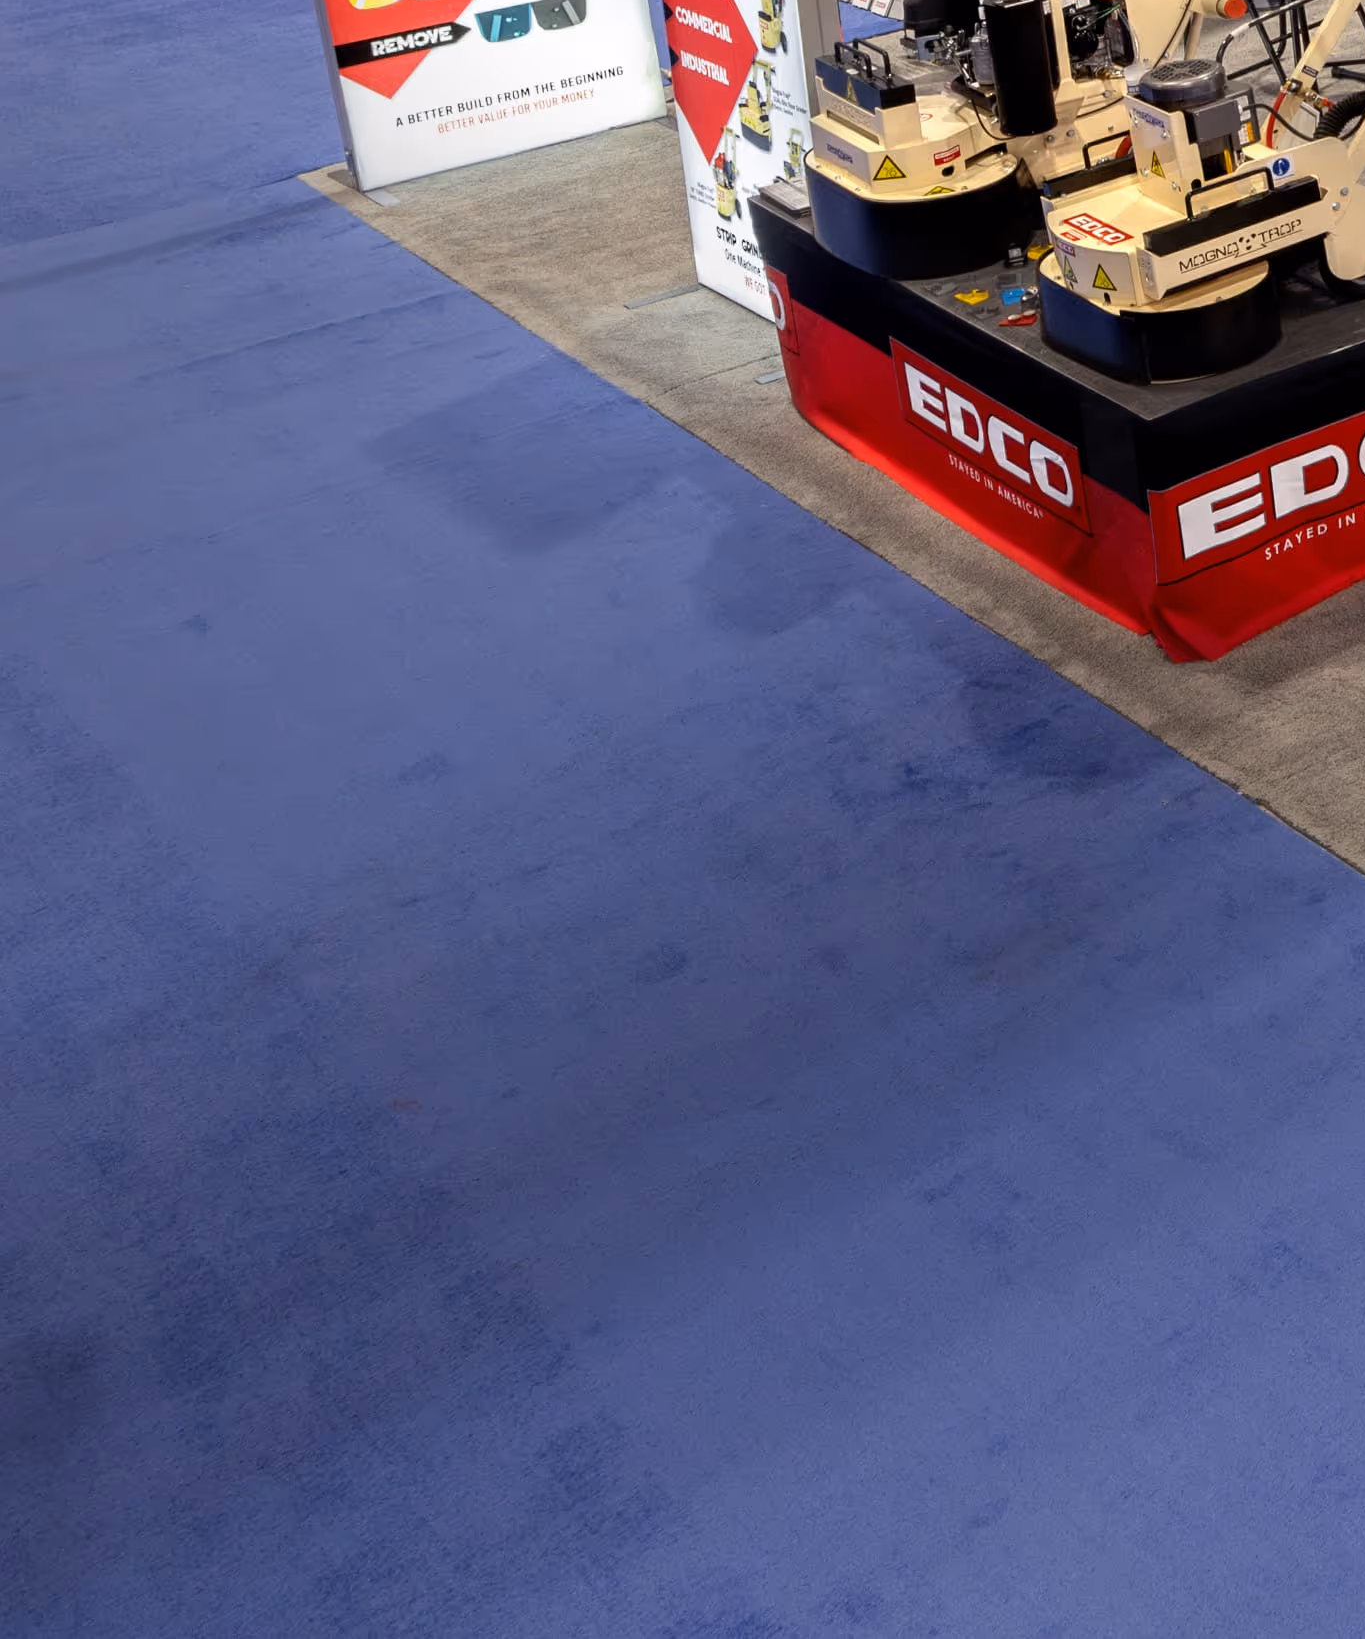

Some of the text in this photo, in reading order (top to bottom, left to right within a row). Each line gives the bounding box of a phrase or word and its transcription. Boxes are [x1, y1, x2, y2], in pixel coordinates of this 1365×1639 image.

[370, 26, 453, 56] REMOVE
[675, 7, 733, 44] COMMERCIAL
[680, 50, 730, 86] INDUSTRIAL
[396, 66, 624, 127] A BETTER BUILD FROM THE BEGINNING
[438, 90, 595, 134] BETTER VALUE FOR YOUR MONEY
[1066, 213, 1128, 245] EDCO
[904, 361, 1075, 510] EDCO
[948, 453, 1040, 519] STAYED IN AMERICA
[1264, 523, 1328, 561] STAYED
[1338, 513, 1356, 529] IN
